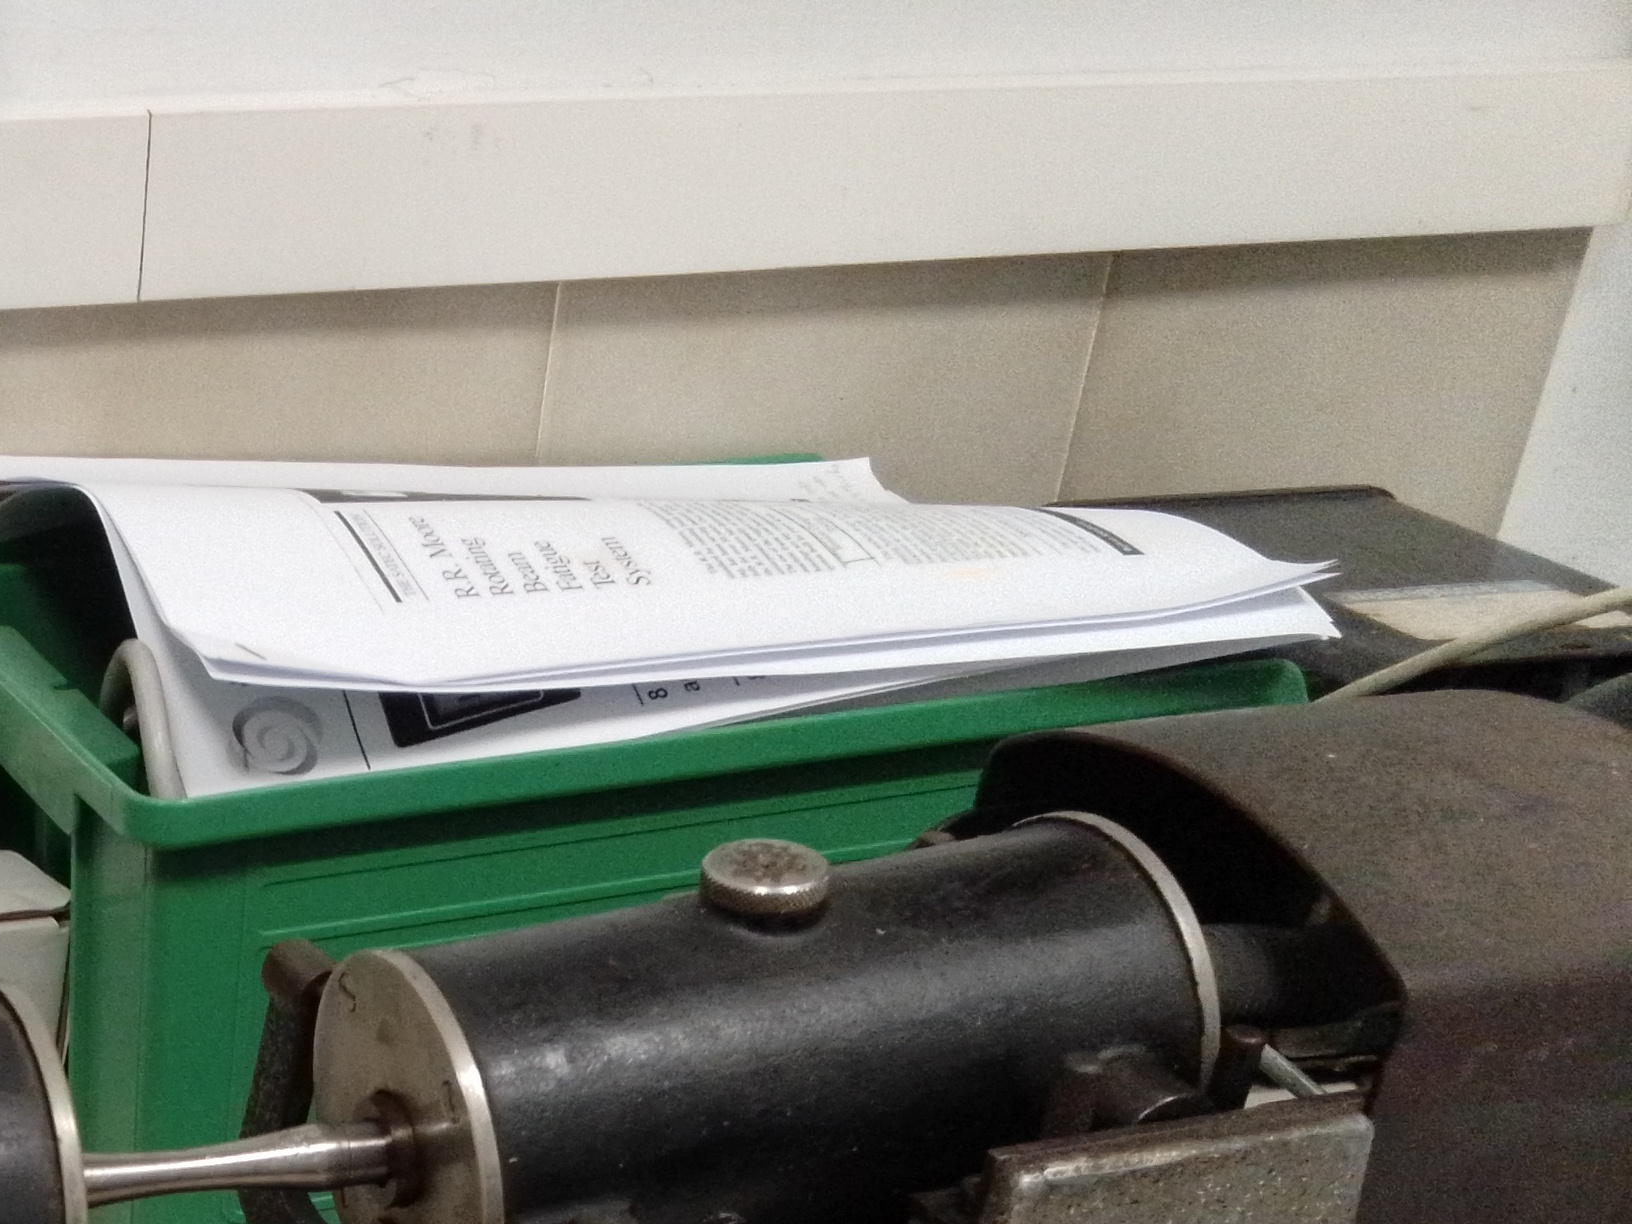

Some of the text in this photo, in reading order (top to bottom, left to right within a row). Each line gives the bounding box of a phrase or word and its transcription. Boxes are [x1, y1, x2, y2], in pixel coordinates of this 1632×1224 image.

[409, 516, 452, 557] Moore
[461, 537, 514, 595] Rotating
[508, 551, 549, 593] Beam
[534, 540, 583, 591] Fatigue
[582, 560, 615, 589] Test
[602, 536, 651, 586] System
